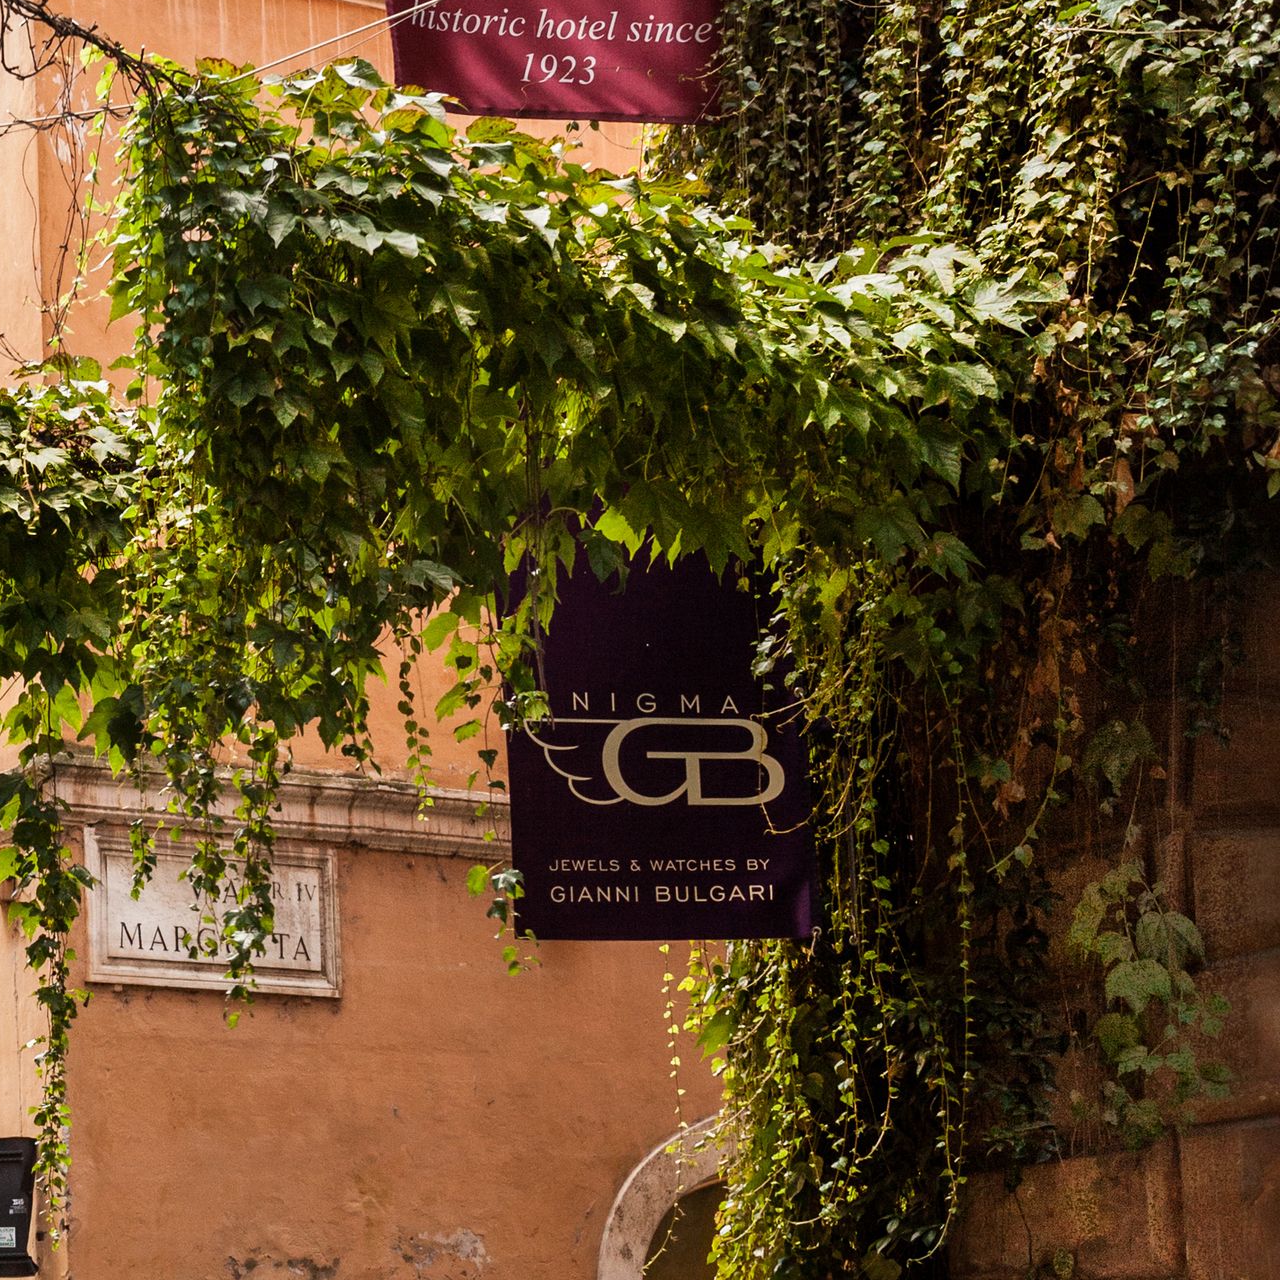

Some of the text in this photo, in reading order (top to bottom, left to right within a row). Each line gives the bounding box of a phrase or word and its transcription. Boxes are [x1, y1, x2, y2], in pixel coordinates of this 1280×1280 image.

[535, 8, 619, 41] hotel
[626, 14, 713, 44] since
[520, 51, 597, 85] 1923
[570, 690, 740, 715] NIGMA
[548, 857, 771, 872] JEWELS & WATCHES BY
[190, 876, 240, 905] VA
[549, 883, 775, 903] GIANNI BULGARI
[119, 921, 312, 962] MARGTA
